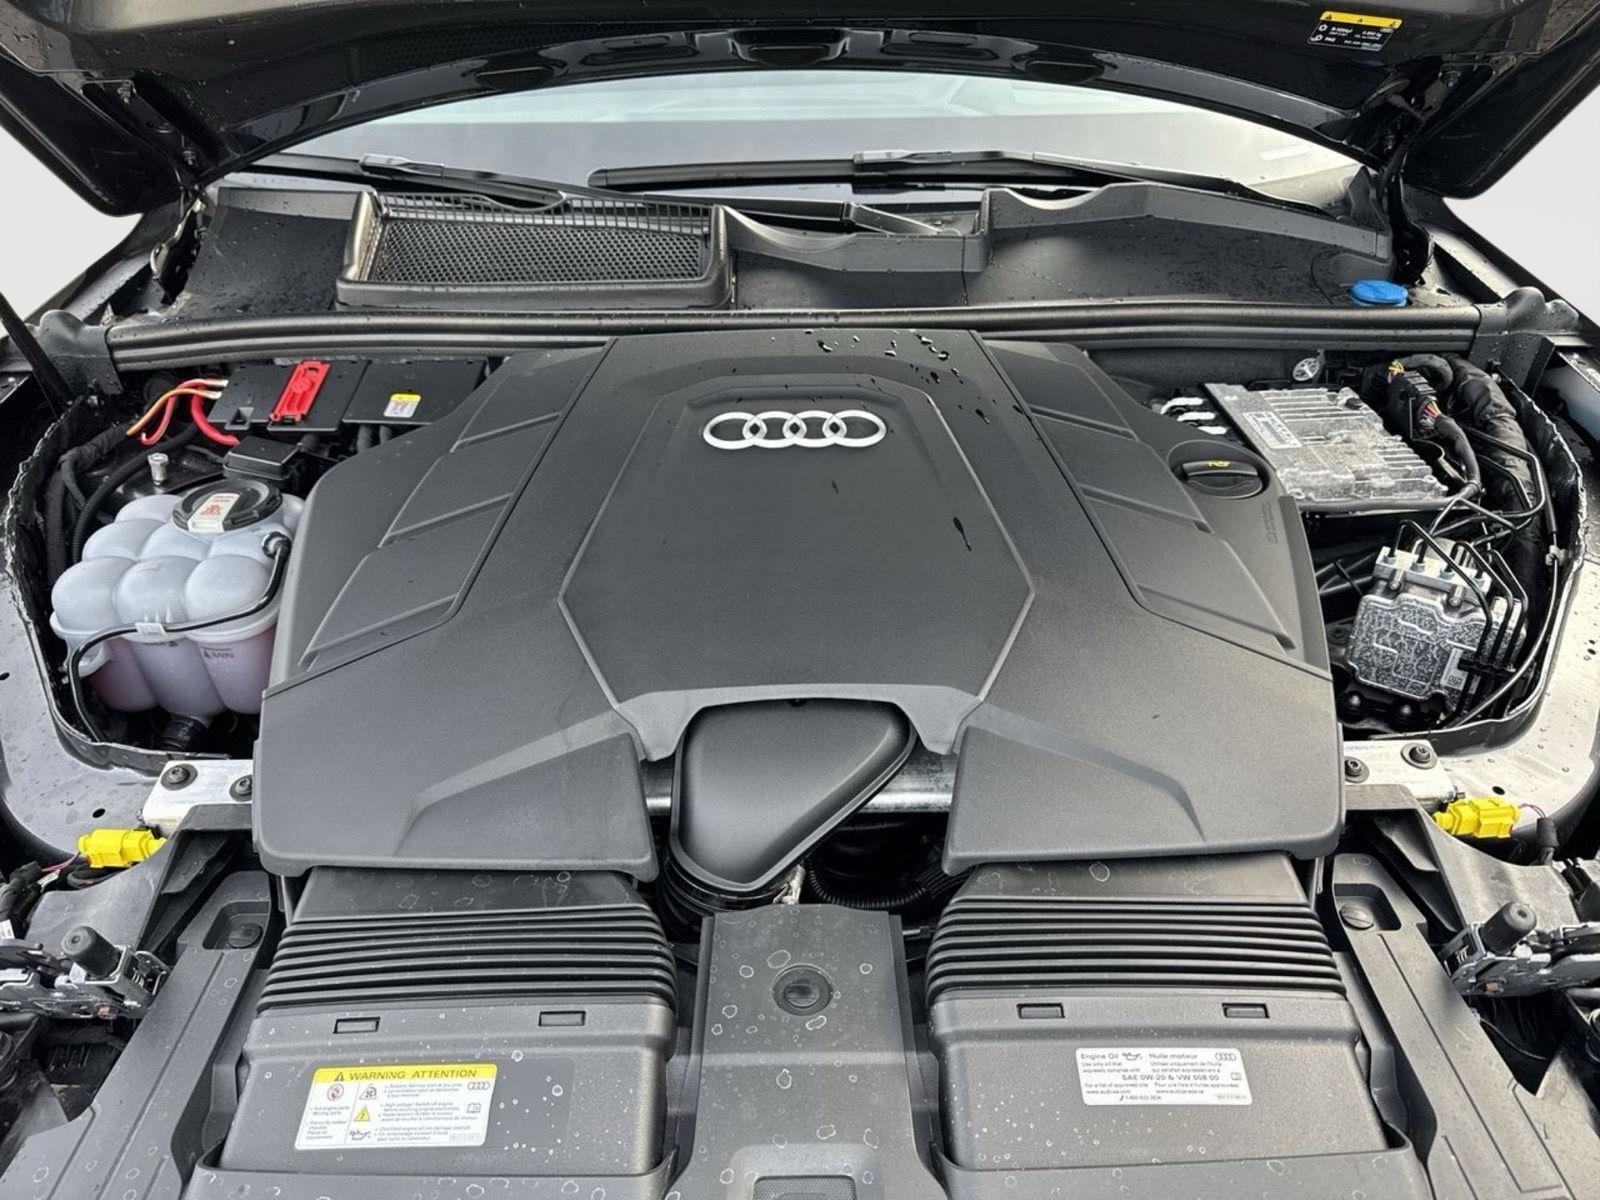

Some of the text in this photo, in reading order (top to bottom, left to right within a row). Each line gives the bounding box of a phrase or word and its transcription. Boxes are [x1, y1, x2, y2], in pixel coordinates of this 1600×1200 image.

[1080, 1053, 1106, 1061] Engine
[348, 1069, 477, 1081] WARNING ATTENTION
